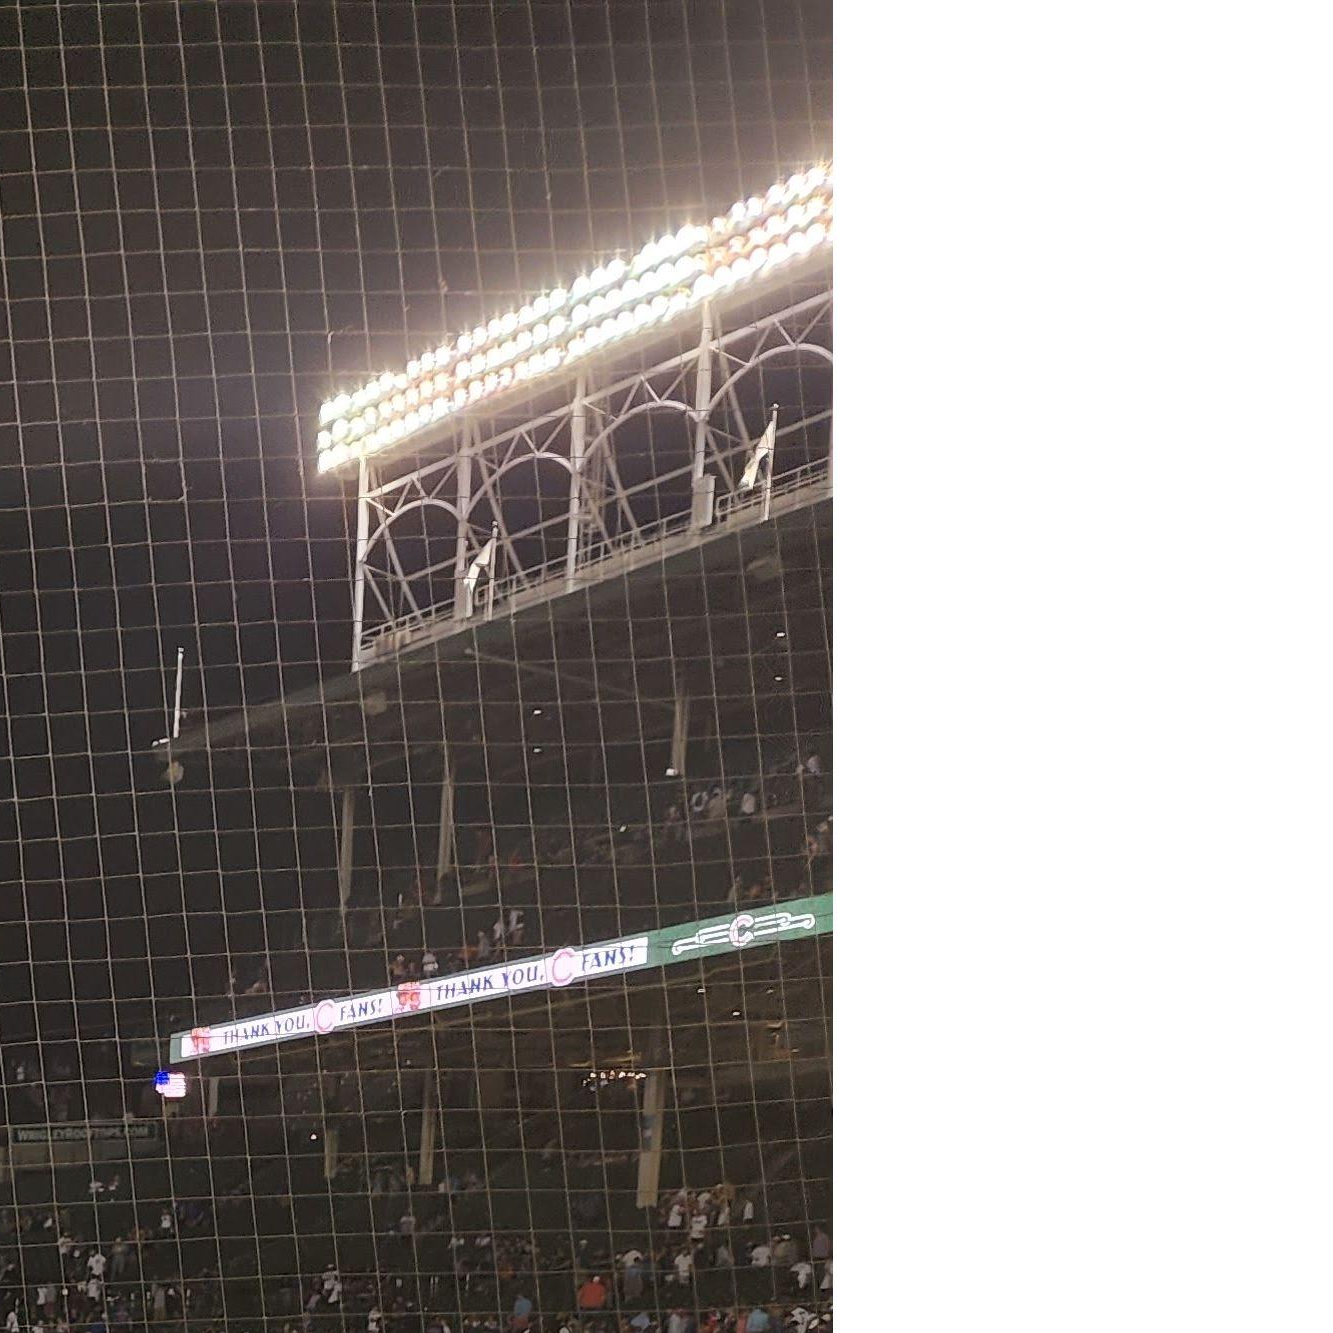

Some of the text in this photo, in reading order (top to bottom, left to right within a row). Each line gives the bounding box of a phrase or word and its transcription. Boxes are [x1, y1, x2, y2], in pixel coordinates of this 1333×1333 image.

[437, 974, 493, 1000] THANK
[582, 945, 635, 971] FANS!
[224, 1022, 269, 1045] THANK
[340, 998, 383, 1021] FANS!
